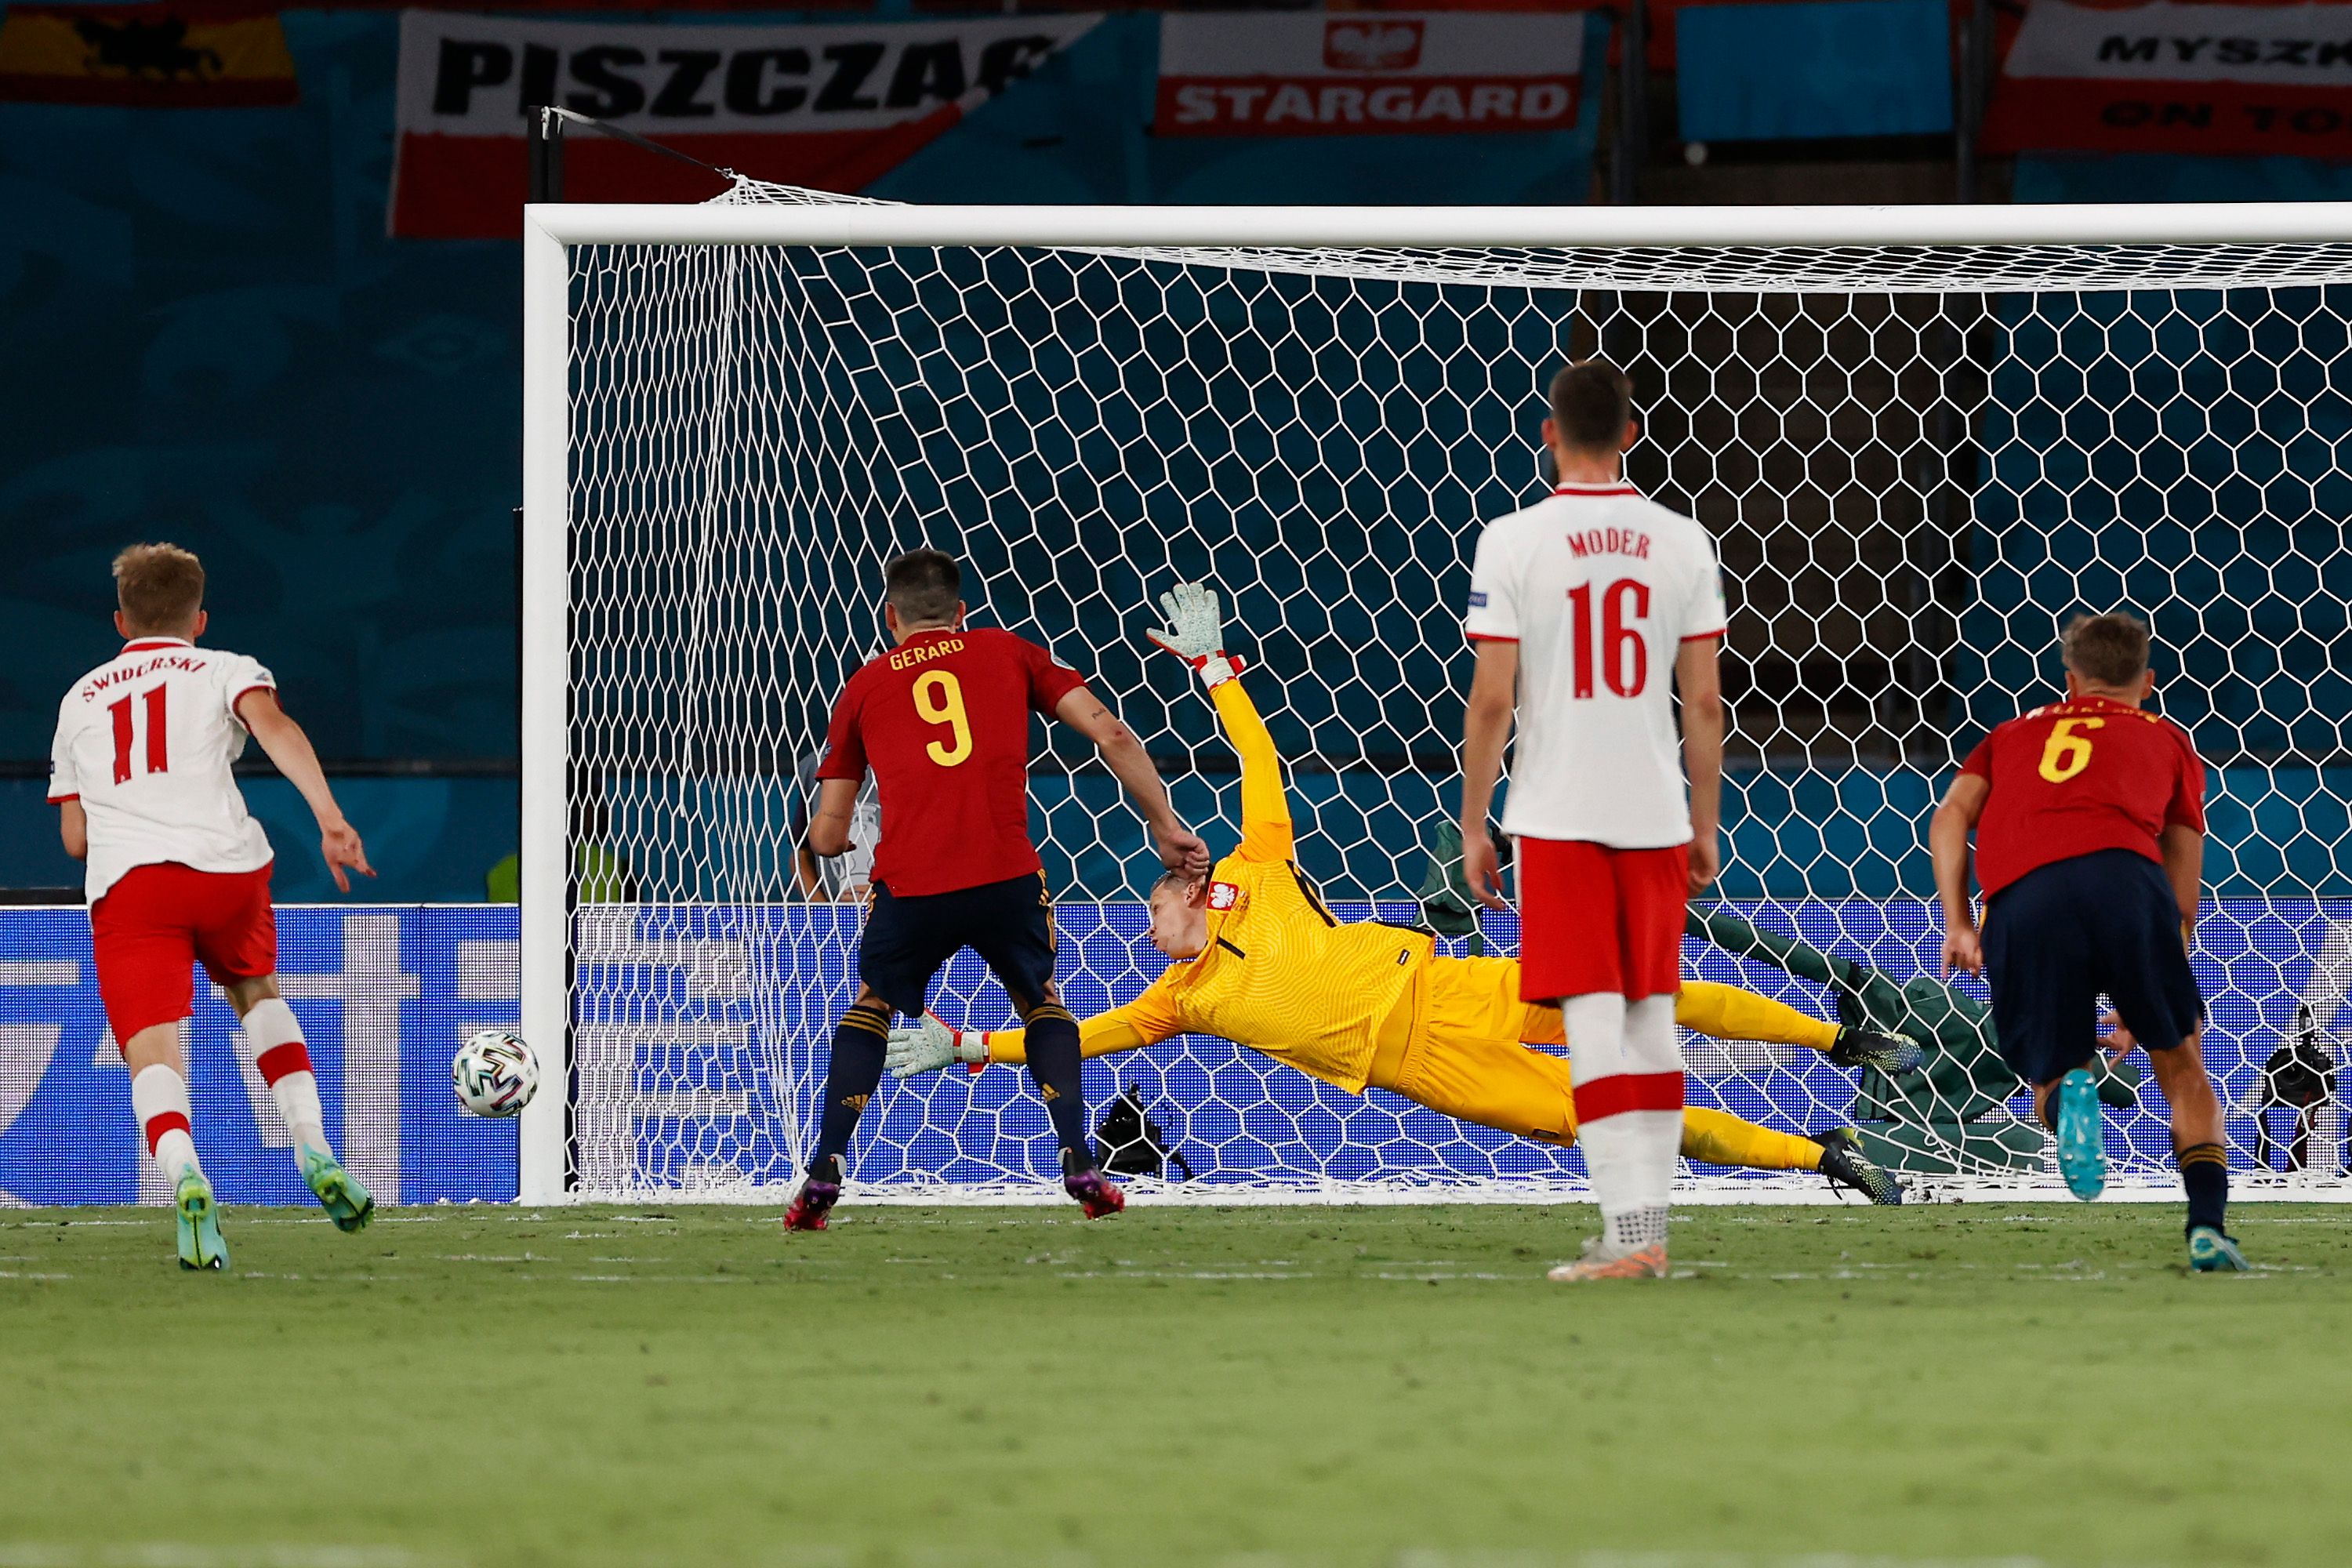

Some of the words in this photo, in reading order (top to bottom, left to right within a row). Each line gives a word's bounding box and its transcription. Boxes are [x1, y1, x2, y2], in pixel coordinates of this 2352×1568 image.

[1176, 83, 1568, 123] STARGARD
[2101, 100, 2213, 128] ON
[2243, 103, 2352, 135] TO
[1566, 527, 1650, 560] MODER
[890, 638, 965, 670] GERARD
[1566, 577, 1650, 699] 16
[107, 681, 169, 786] 11
[912, 670, 973, 767] 9
[2038, 717, 2106, 784] 6
